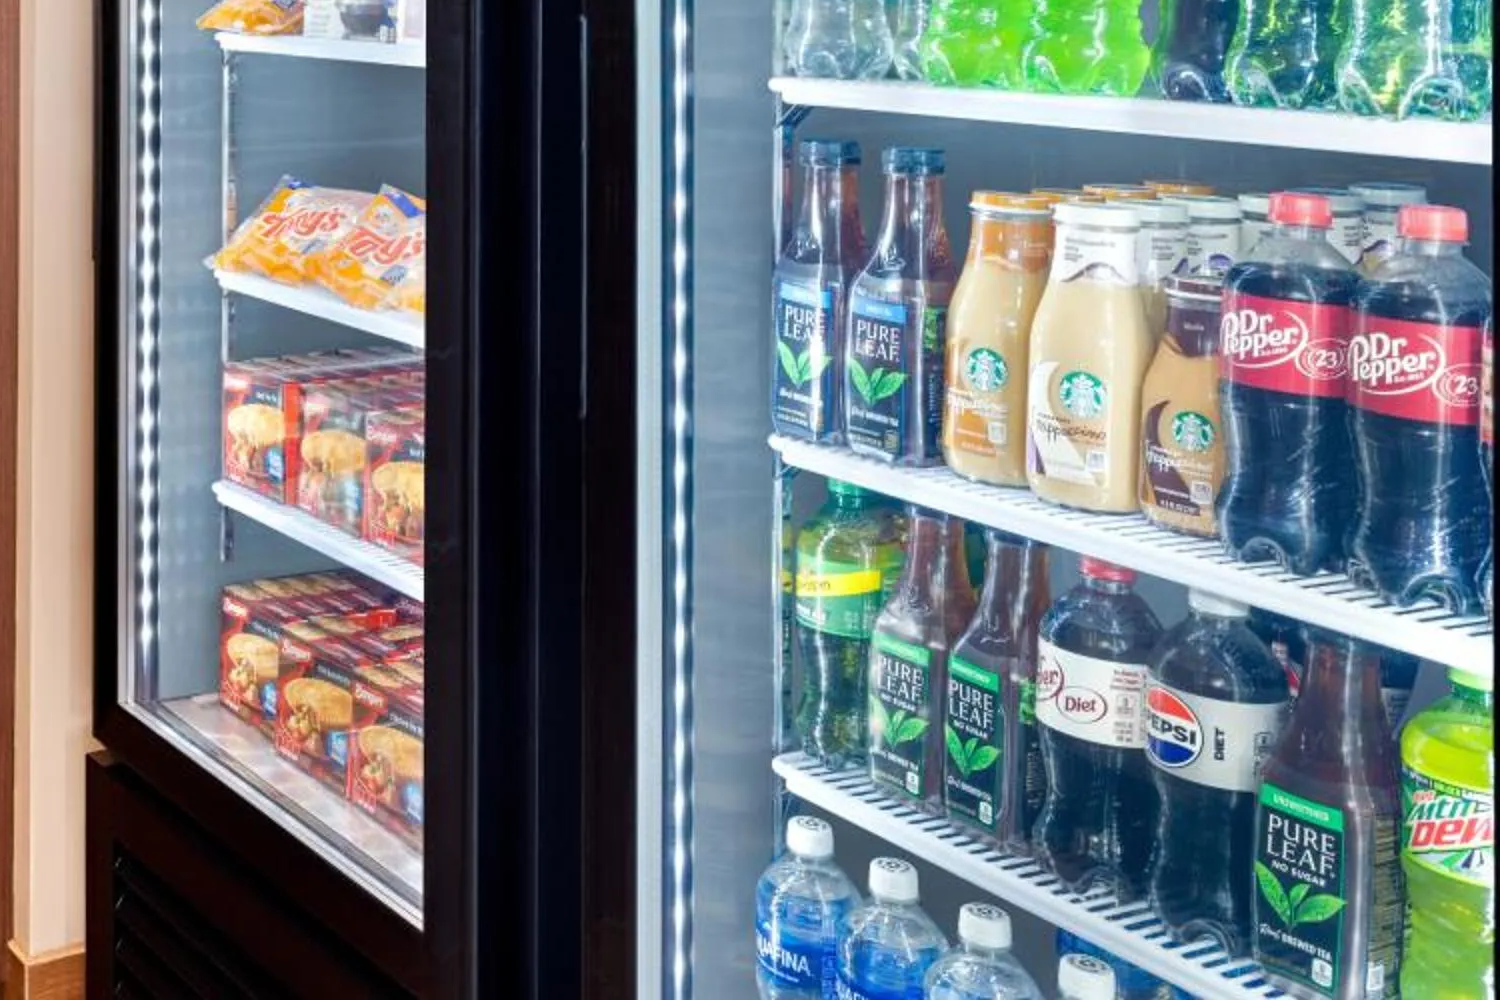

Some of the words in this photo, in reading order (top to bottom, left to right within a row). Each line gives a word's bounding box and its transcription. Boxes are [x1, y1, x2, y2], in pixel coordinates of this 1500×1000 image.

[856, 319, 901, 343] PURE
[1220, 312, 1298, 360] Pepper
[1238, 309, 1274, 336] Dr
[855, 338, 901, 363] LEAF
[1313, 349, 1338, 368] 23
[1349, 335, 1434, 386] Pepper
[1370, 332, 1409, 360] Dr
[1454, 374, 1479, 396] 23
[878, 652, 924, 685] PURE
[878, 673, 923, 703] LEAF
[949, 679, 994, 713] PURE
[949, 697, 994, 731] LEAF
[1064, 695, 1097, 713] Diet
[1150, 713, 1197, 746] EPSI
[1213, 726, 1226, 761] DIET
[1267, 812, 1337, 857] PURE
[1266, 834, 1336, 879] LEAF
[1271, 859, 1290, 874] NO
[1291, 866, 1327, 888] SUGAR
